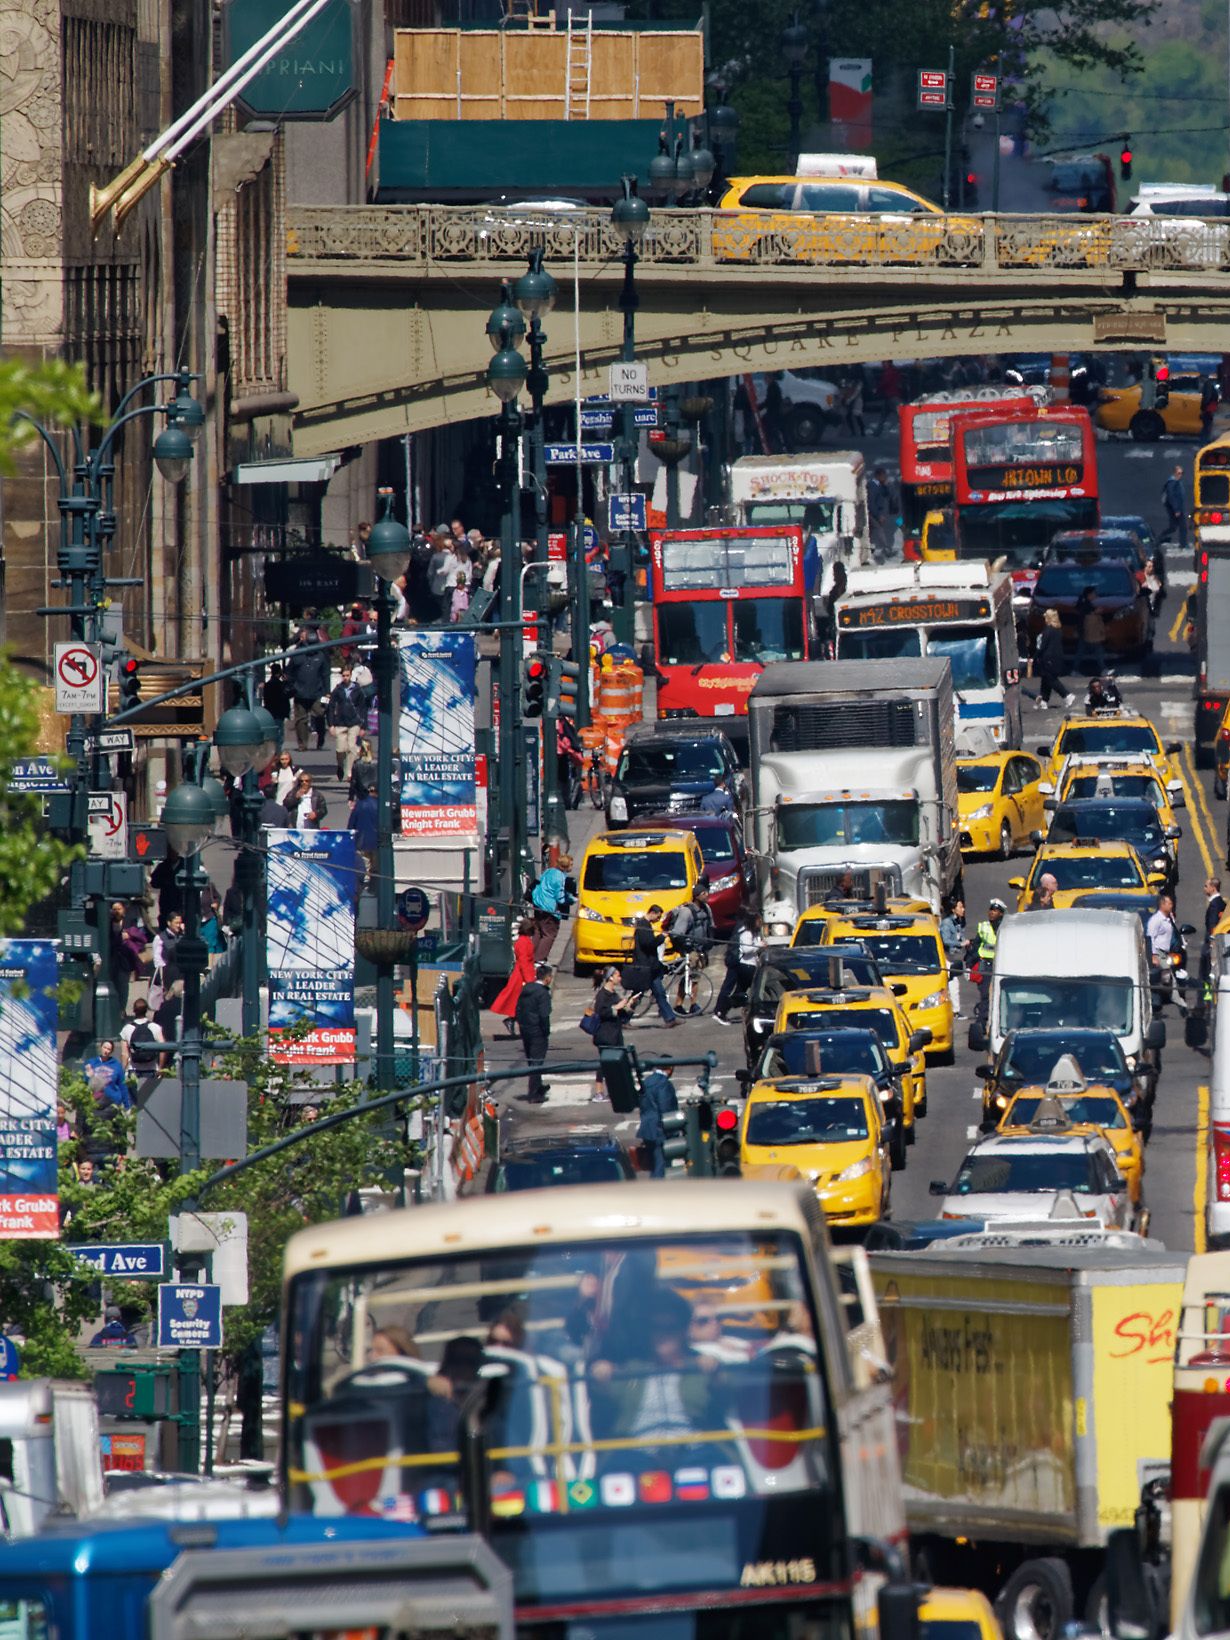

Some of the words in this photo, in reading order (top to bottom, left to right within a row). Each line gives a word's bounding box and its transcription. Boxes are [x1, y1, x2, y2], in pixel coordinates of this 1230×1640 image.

[259, 60, 344, 75] PRIANI
[710, 329, 860, 362] SQUARE
[891, 322, 1014, 344] PLAZA
[621, 368, 637, 380] NO
[613, 384, 646, 395] TURNS
[551, 449, 577, 460] Park
[579, 449, 601, 459] Ave
[859, 608, 885, 625] M42
[889, 602, 959, 622] CROSSTOWN
[61, 689, 97, 700] 7AM-7PM
[107, 735, 126, 744] WAY
[450, 754, 475, 762] CITY:
[27, 762, 54, 775] Ave
[425, 763, 459, 771] LEADER
[401, 808, 445, 818] Newmark
[446, 808, 475, 818] Grubb
[402, 819, 433, 831] Knight
[434, 819, 461, 828] Frank
[269, 970, 293, 979] NEW
[295, 970, 324, 979] YORK
[326, 970, 353, 979] CITY:
[287, 982, 294, 990] A
[295, 981, 336, 990] LEADER
[272, 991, 285, 1000] IN
[287, 991, 314, 1000] REAL
[315, 991, 351, 1000] ESTATE
[321, 1031, 353, 1043] Grubb
[306, 1044, 336, 1055] Frank
[0, 1119, 20, 1131] RK
[21, 1119, 55, 1131] CITY:
[0, 1134, 33, 1146] ADER
[6, 1147, 53, 1159] ESTATE
[15, 1199, 57, 1213] Grubb
[111, 1253, 147, 1271] Ave
[176, 1288, 205, 1299] NYPD
[169, 1318, 211, 1331] Security
[171, 1329, 210, 1339] Camera
